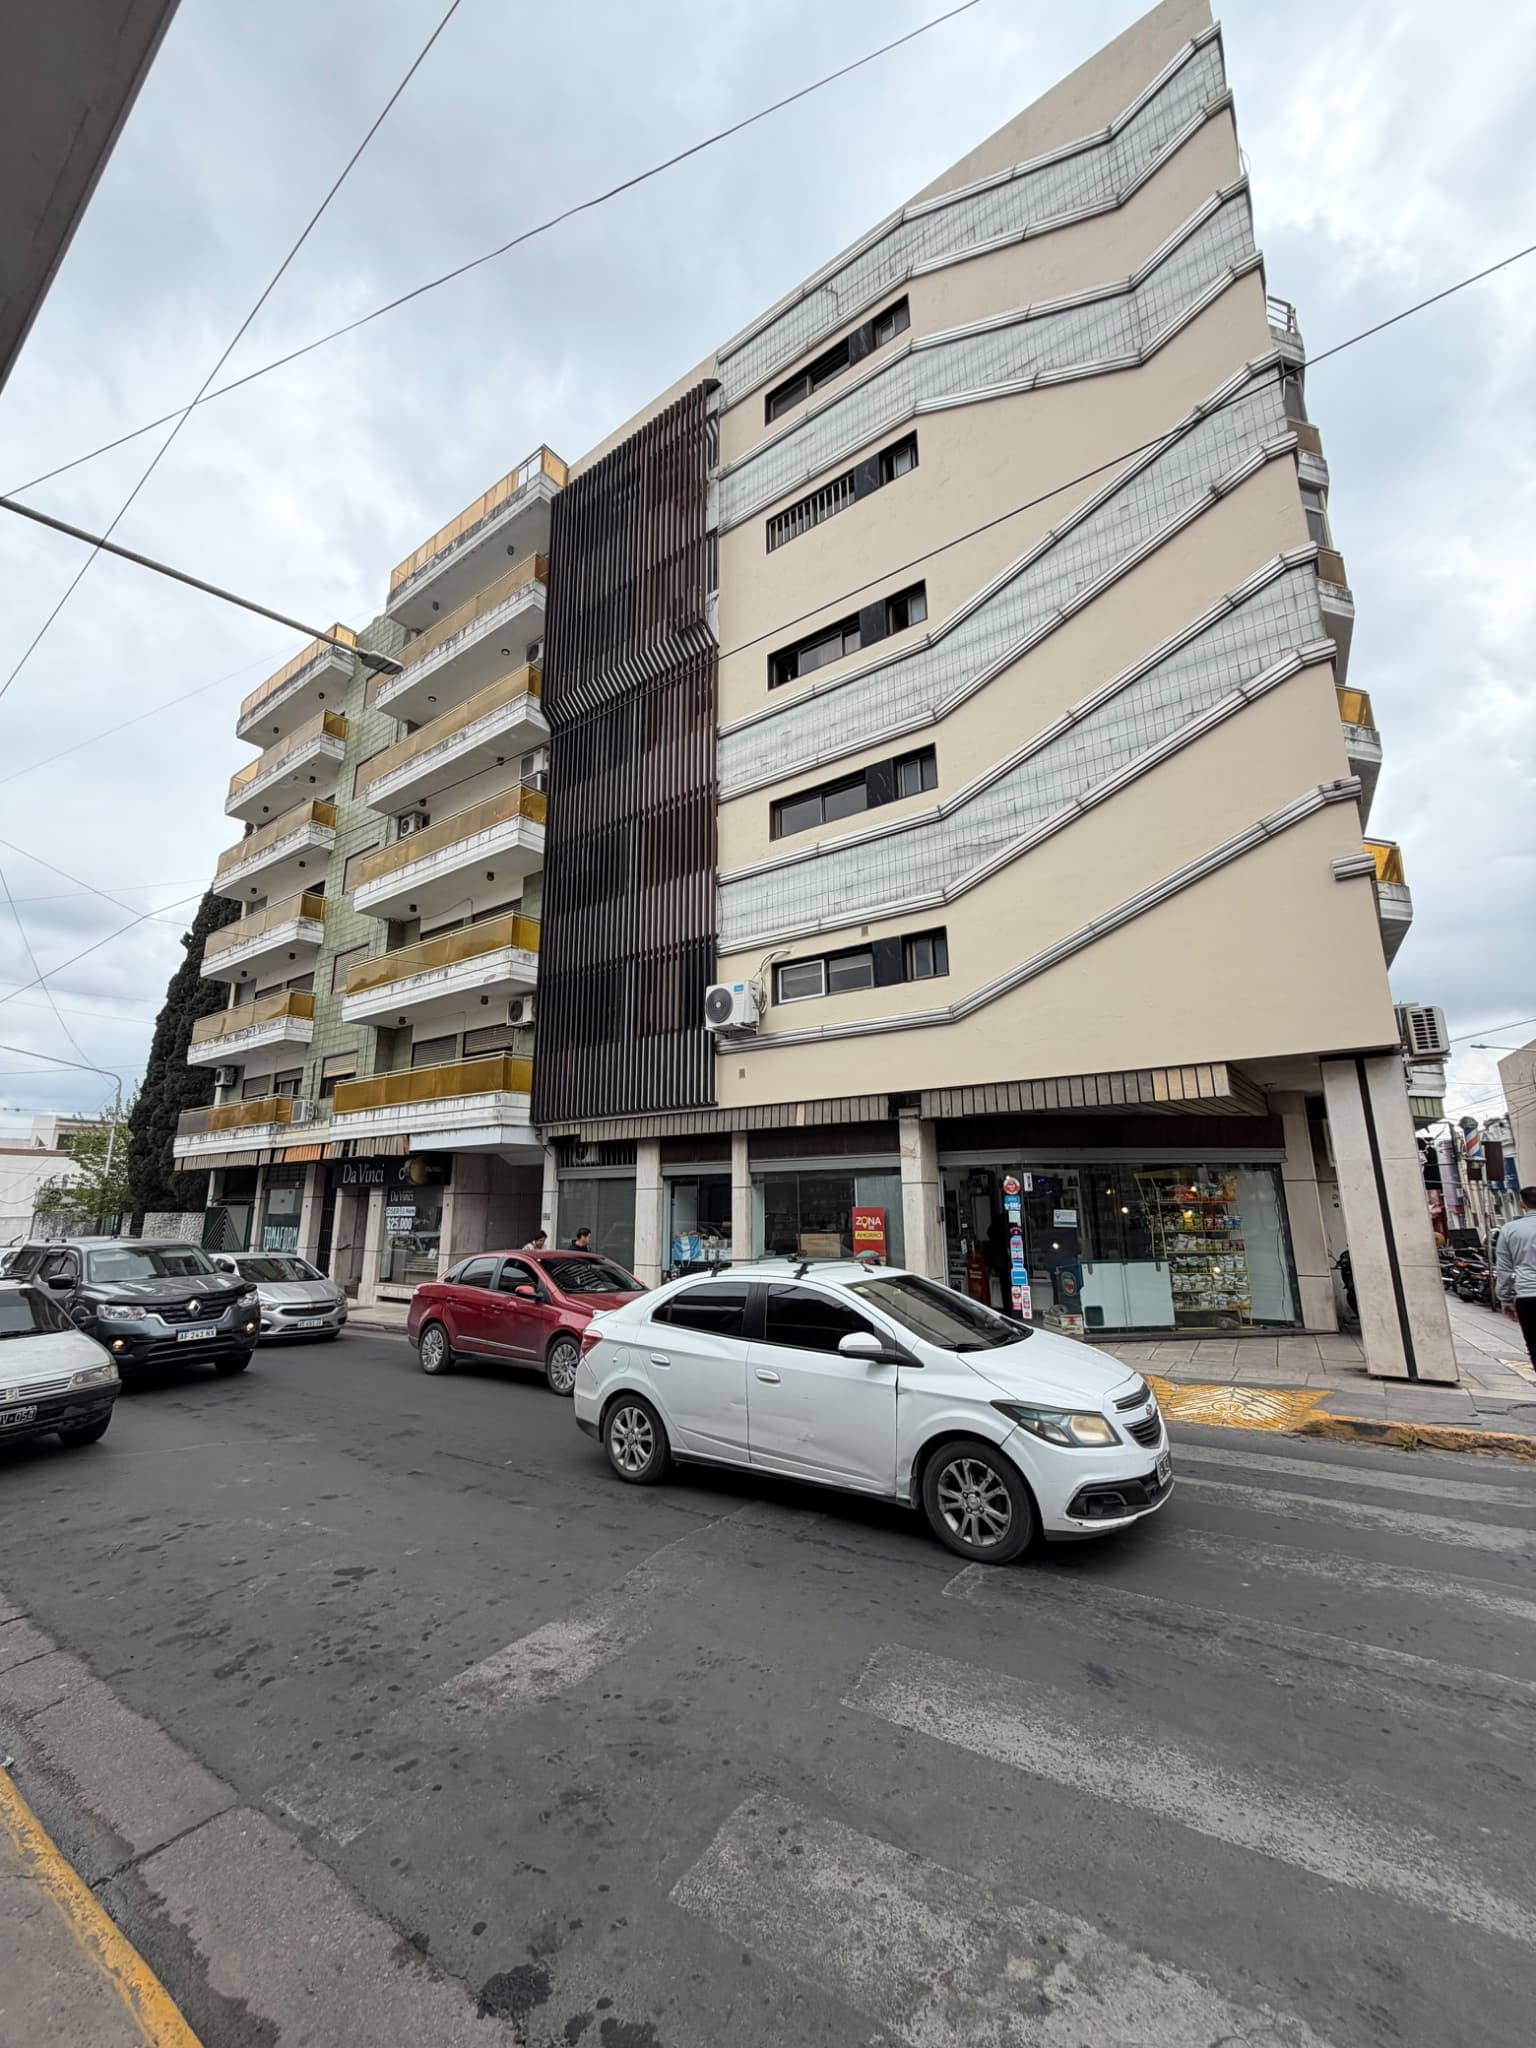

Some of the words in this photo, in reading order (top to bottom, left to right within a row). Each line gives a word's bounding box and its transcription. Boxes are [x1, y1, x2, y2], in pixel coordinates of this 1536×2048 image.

[343, 1164, 357, 1183] Da
[359, 1163, 384, 1183] Vinci
[856, 1216, 882, 1227] ZONA
